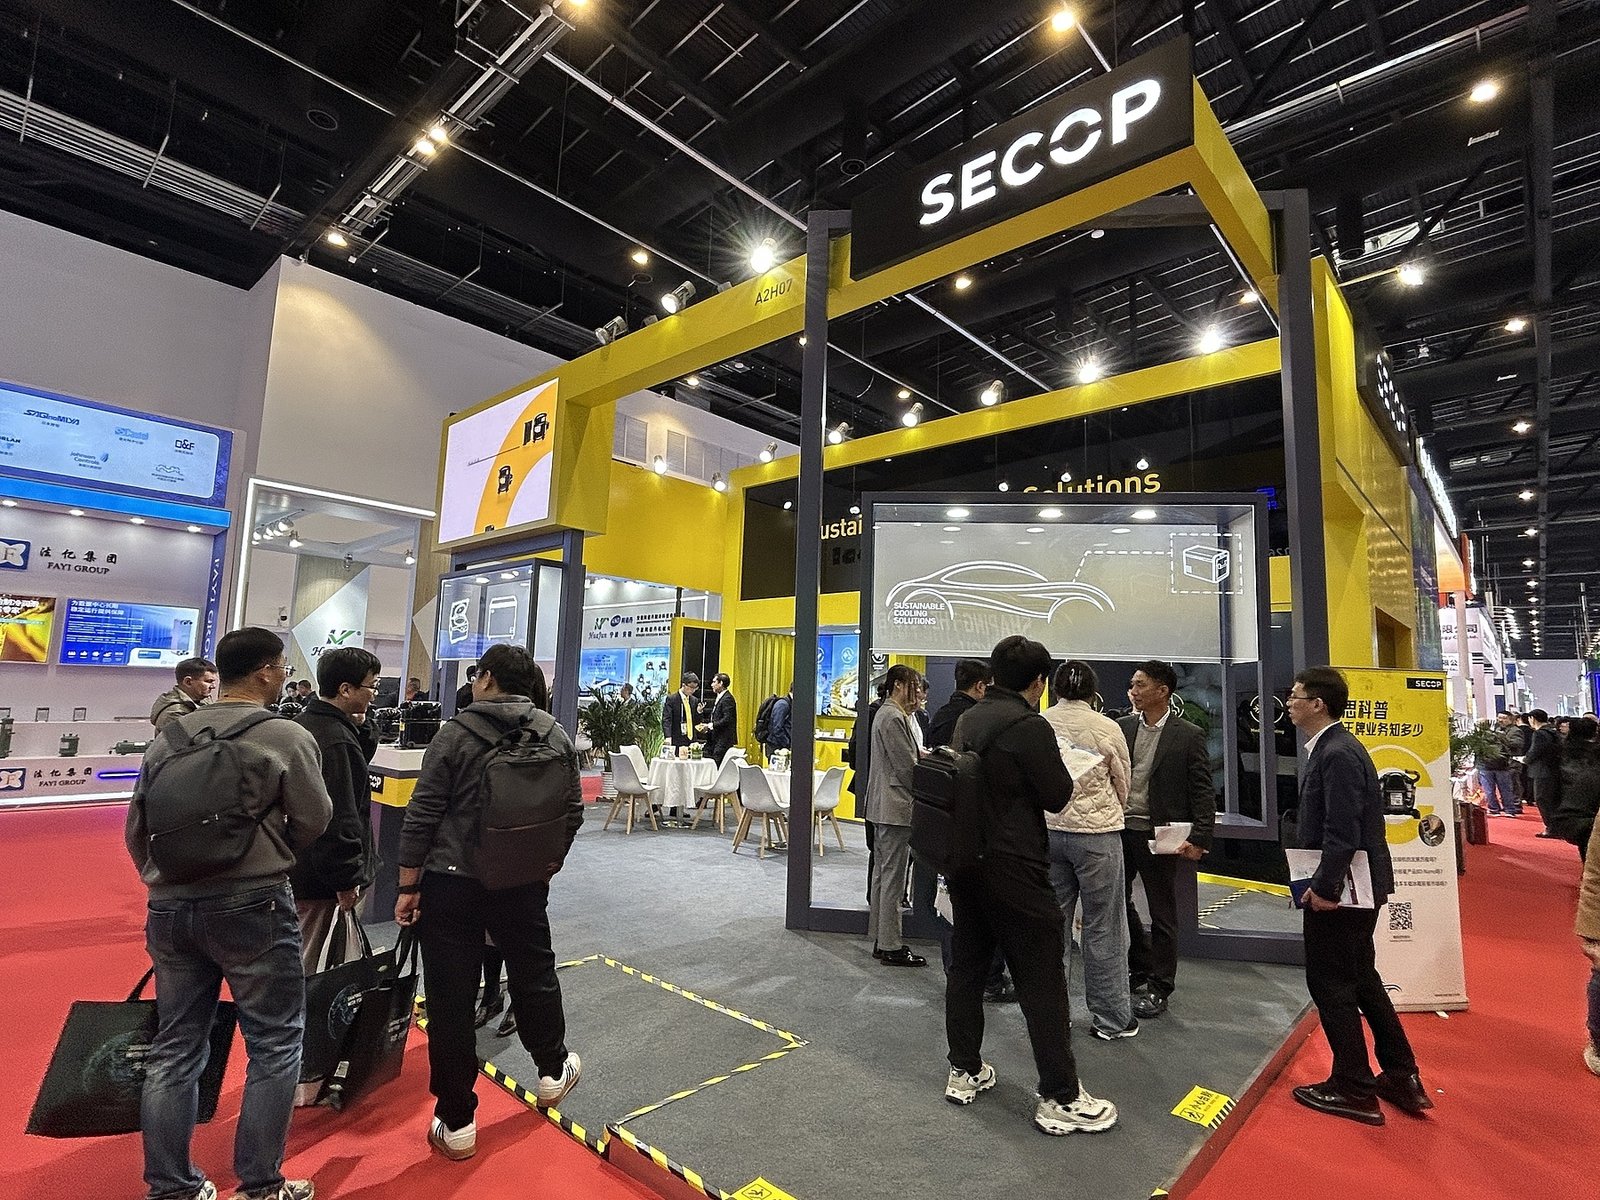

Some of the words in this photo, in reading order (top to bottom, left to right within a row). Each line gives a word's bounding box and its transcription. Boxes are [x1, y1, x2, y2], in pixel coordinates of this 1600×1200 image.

[919, 79, 1161, 225] SECOP
[755, 278, 793, 306] A2H07
[1023, 473, 1161, 493] tions
[47, 562, 71, 571] FAYI
[74, 564, 110, 574] GROUP
[893, 602, 945, 610] SUSTAINABLE
[893, 617, 936, 625] SOLUTIONS
[1415, 680, 1442, 688] SECOP
[1342, 700, 1388, 719] 思科普
[1343, 721, 1424, 737] 王牌业务知多少
[58, 779, 87, 787] GROUP
